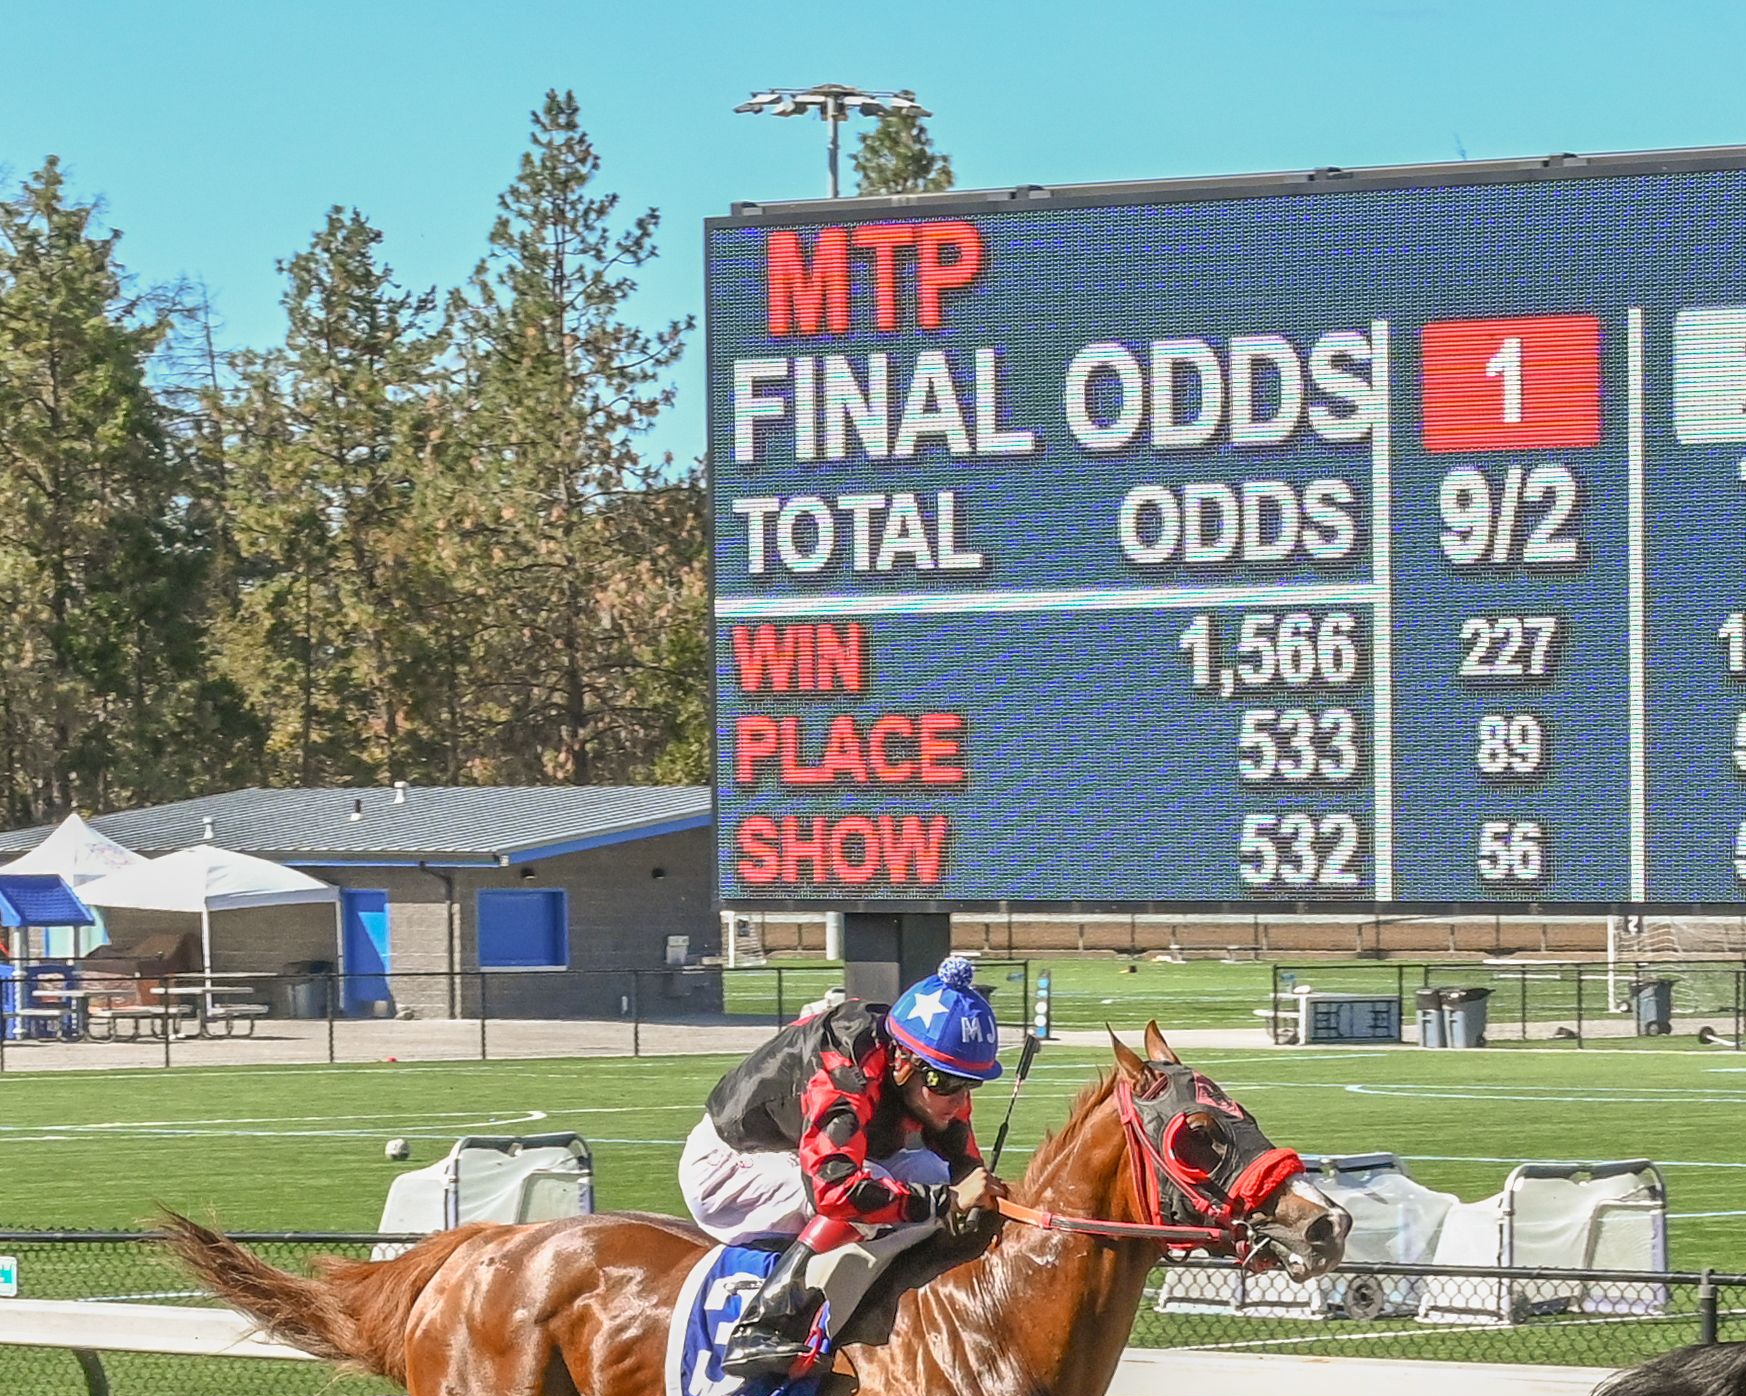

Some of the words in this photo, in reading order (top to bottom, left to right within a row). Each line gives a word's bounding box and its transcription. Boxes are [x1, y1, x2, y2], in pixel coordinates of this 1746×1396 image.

[768, 221, 982, 336] MTP
[734, 348, 1034, 462] FINAL
[1065, 332, 1372, 449] ODDS
[1486, 338, 1520, 423] 1
[733, 491, 982, 573] TOTAL
[1119, 479, 1354, 563] ODDS
[1440, 465, 1576, 563] 9/2
[734, 624, 862, 692] WIN
[1180, 613, 1356, 697] 1,566
[1461, 617, 1555, 675] 227
[738, 713, 963, 784] PLACE
[1240, 708, 1357, 780] 533
[1478, 715, 1540, 772] 89
[739, 816, 946, 884] SHOW
[1241, 813, 1358, 885] 532
[1478, 822, 1540, 879] 56
